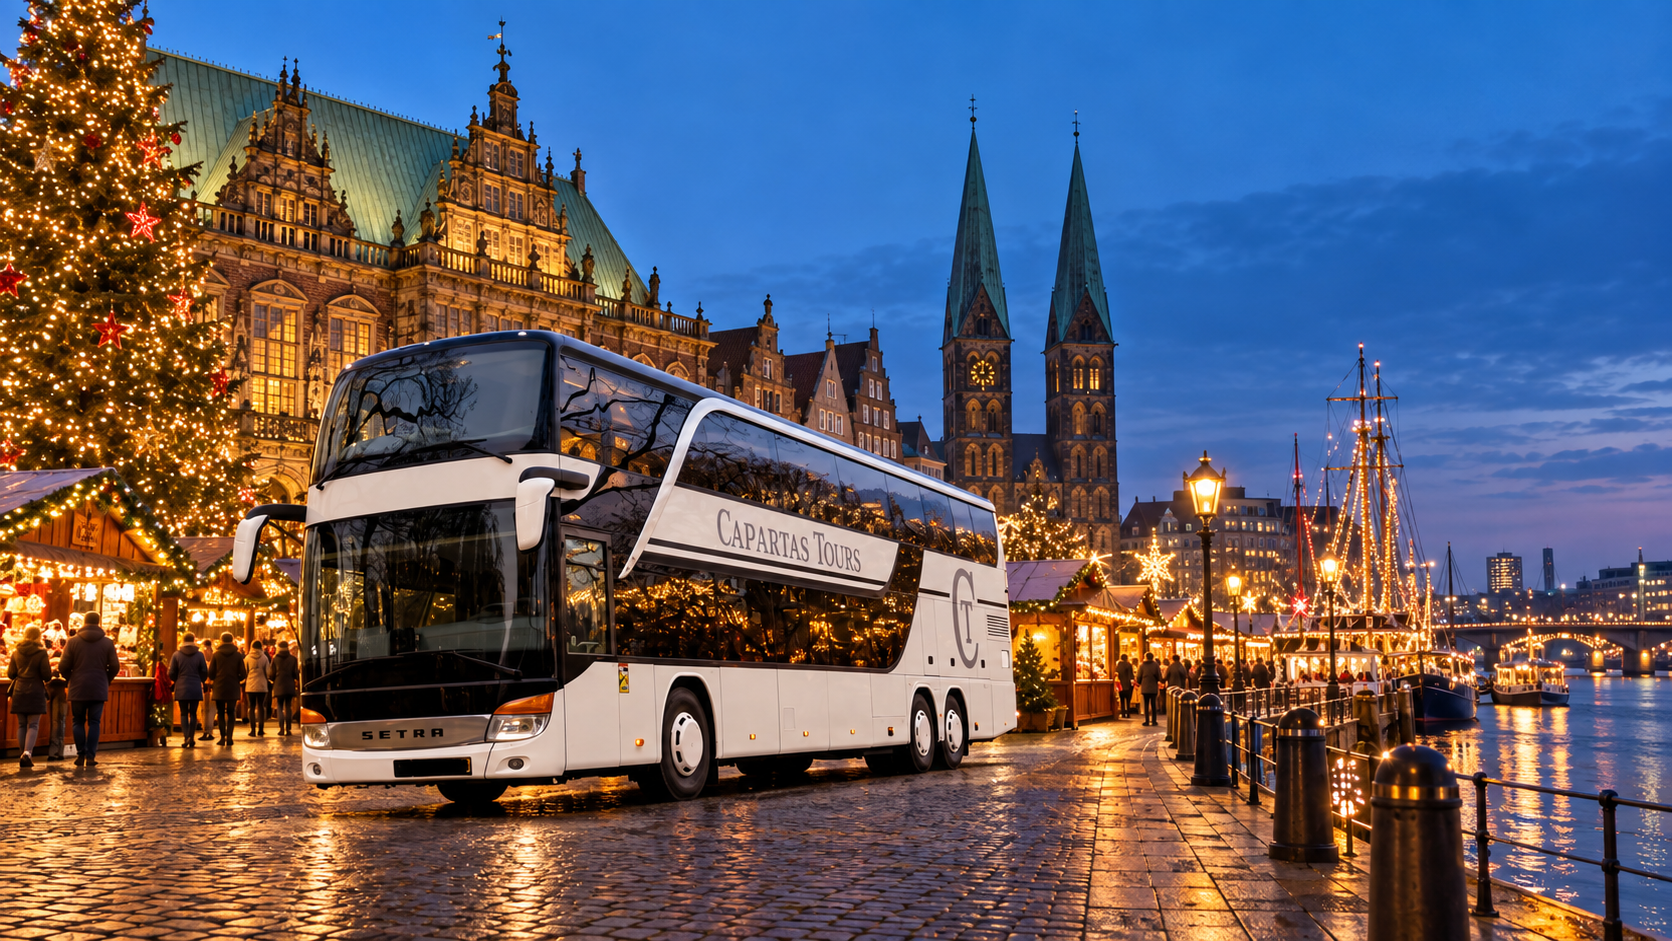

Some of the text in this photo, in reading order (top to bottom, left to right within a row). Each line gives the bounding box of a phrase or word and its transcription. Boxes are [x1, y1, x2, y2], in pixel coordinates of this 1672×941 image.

[716, 508, 862, 573] CAPARTAS TOURS
[361, 728, 444, 741] SETRA
